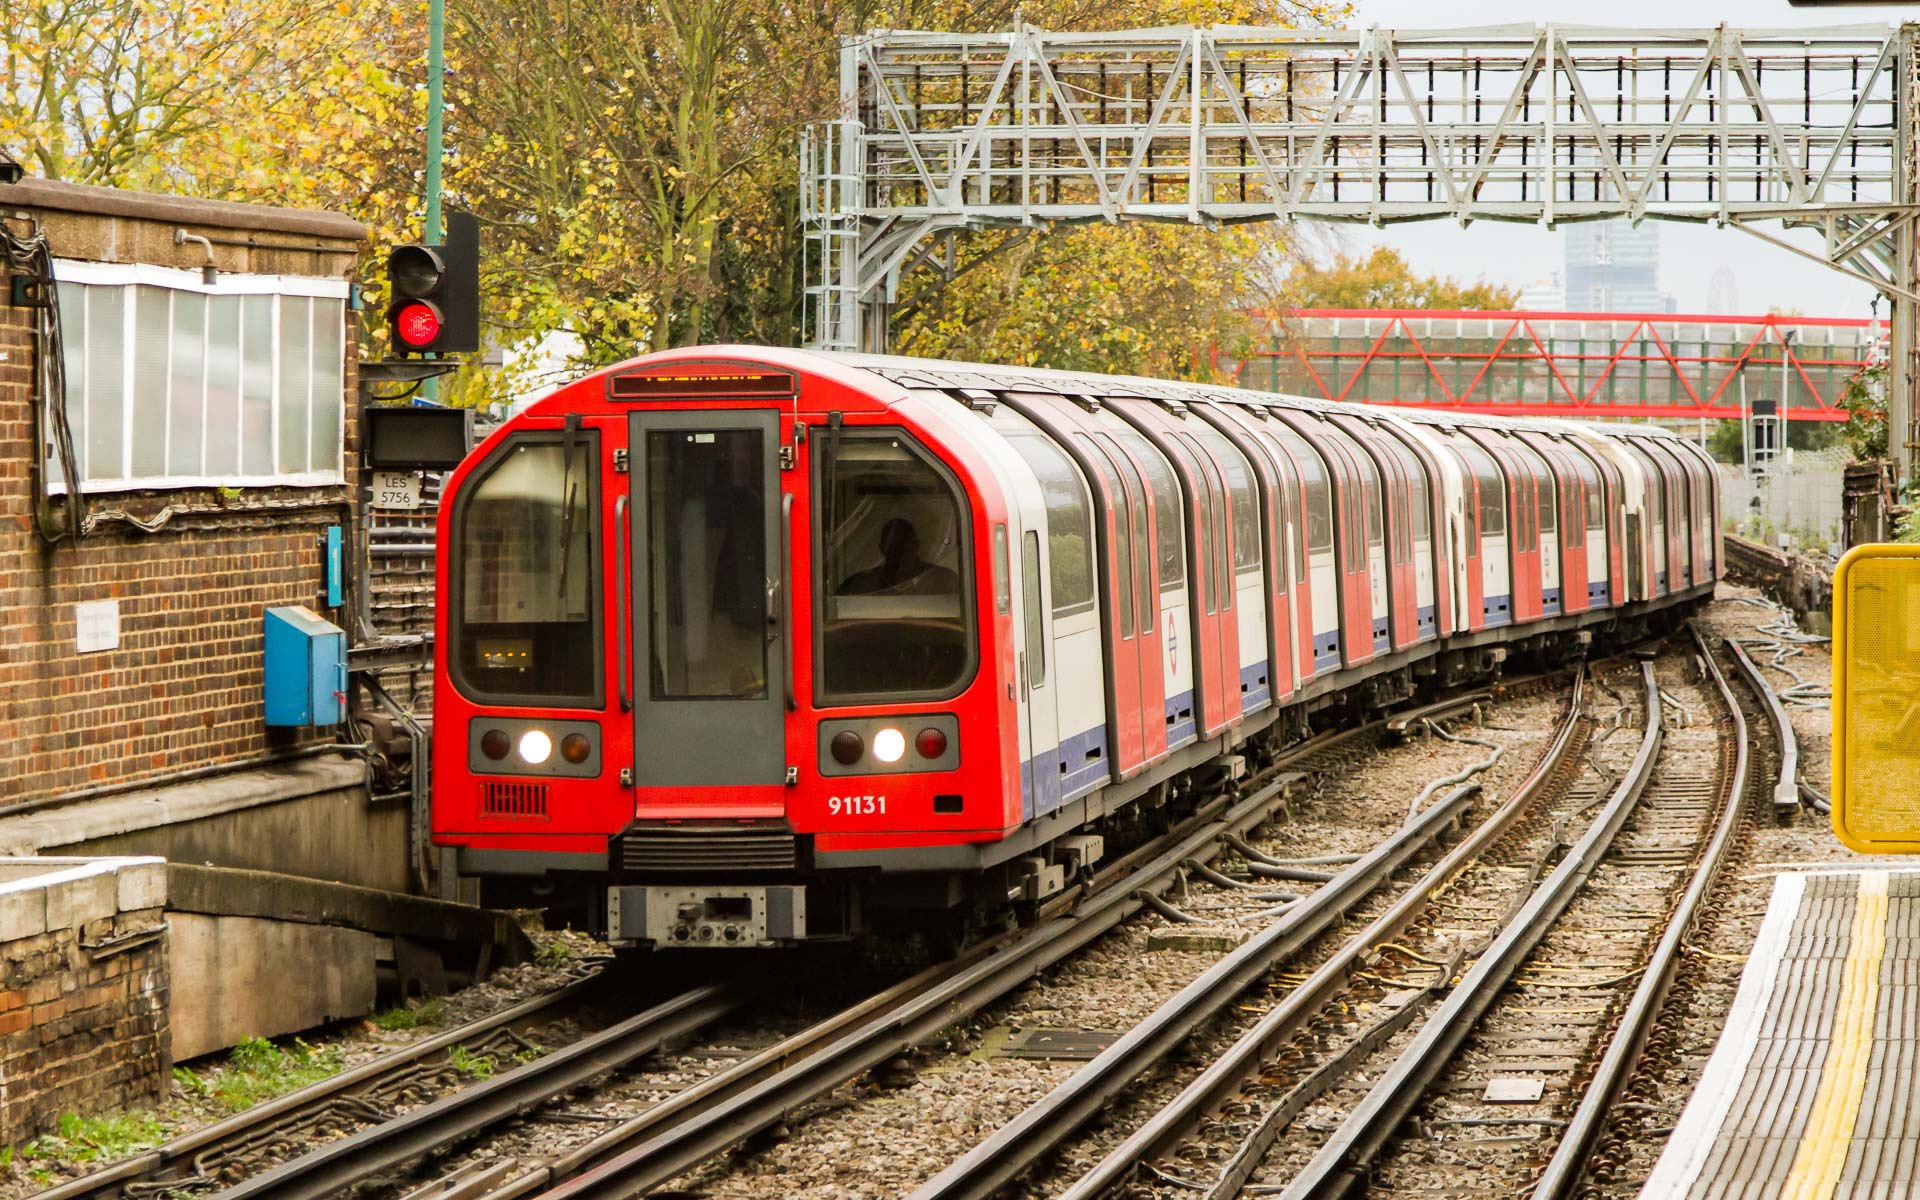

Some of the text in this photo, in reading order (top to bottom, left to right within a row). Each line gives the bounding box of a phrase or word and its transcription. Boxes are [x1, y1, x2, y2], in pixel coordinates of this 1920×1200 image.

[385, 477, 407, 488] LES
[381, 491, 410, 503] 5756
[332, 546, 339, 586] 1
[828, 796, 886, 815] 91131
